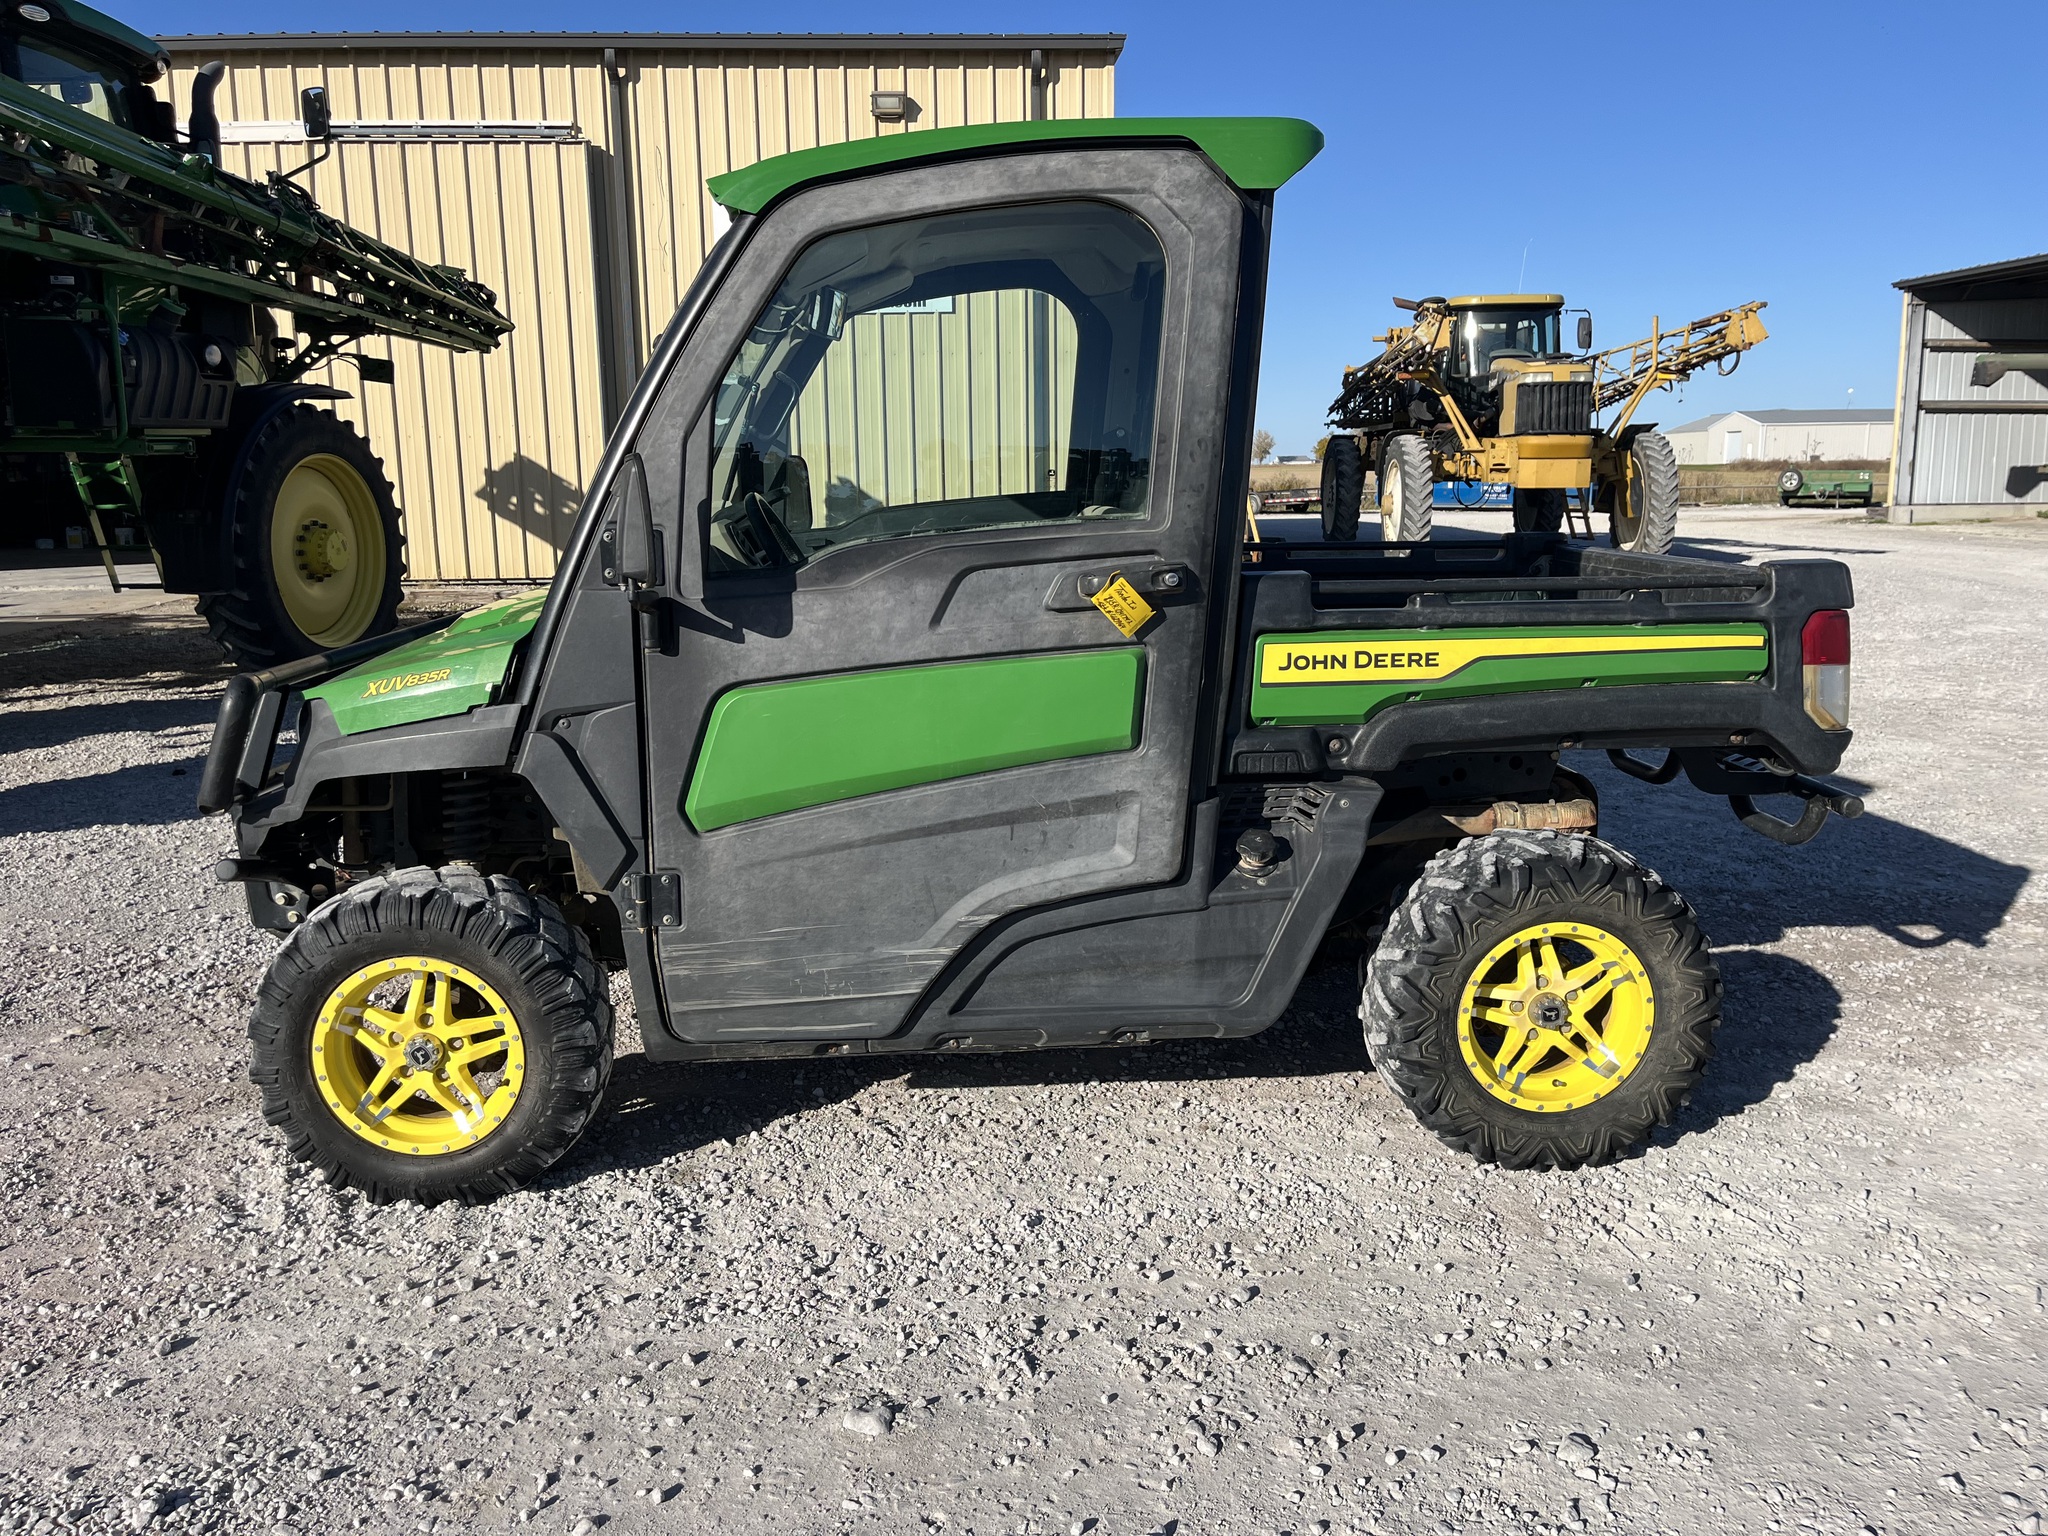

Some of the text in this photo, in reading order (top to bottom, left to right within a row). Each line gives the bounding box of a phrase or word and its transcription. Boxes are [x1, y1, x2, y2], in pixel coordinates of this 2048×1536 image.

[1278, 650, 1440, 671] JOHN DEERE
[361, 668, 452, 699] XUV835R
[519, 1043, 553, 1138] CARLISLE
